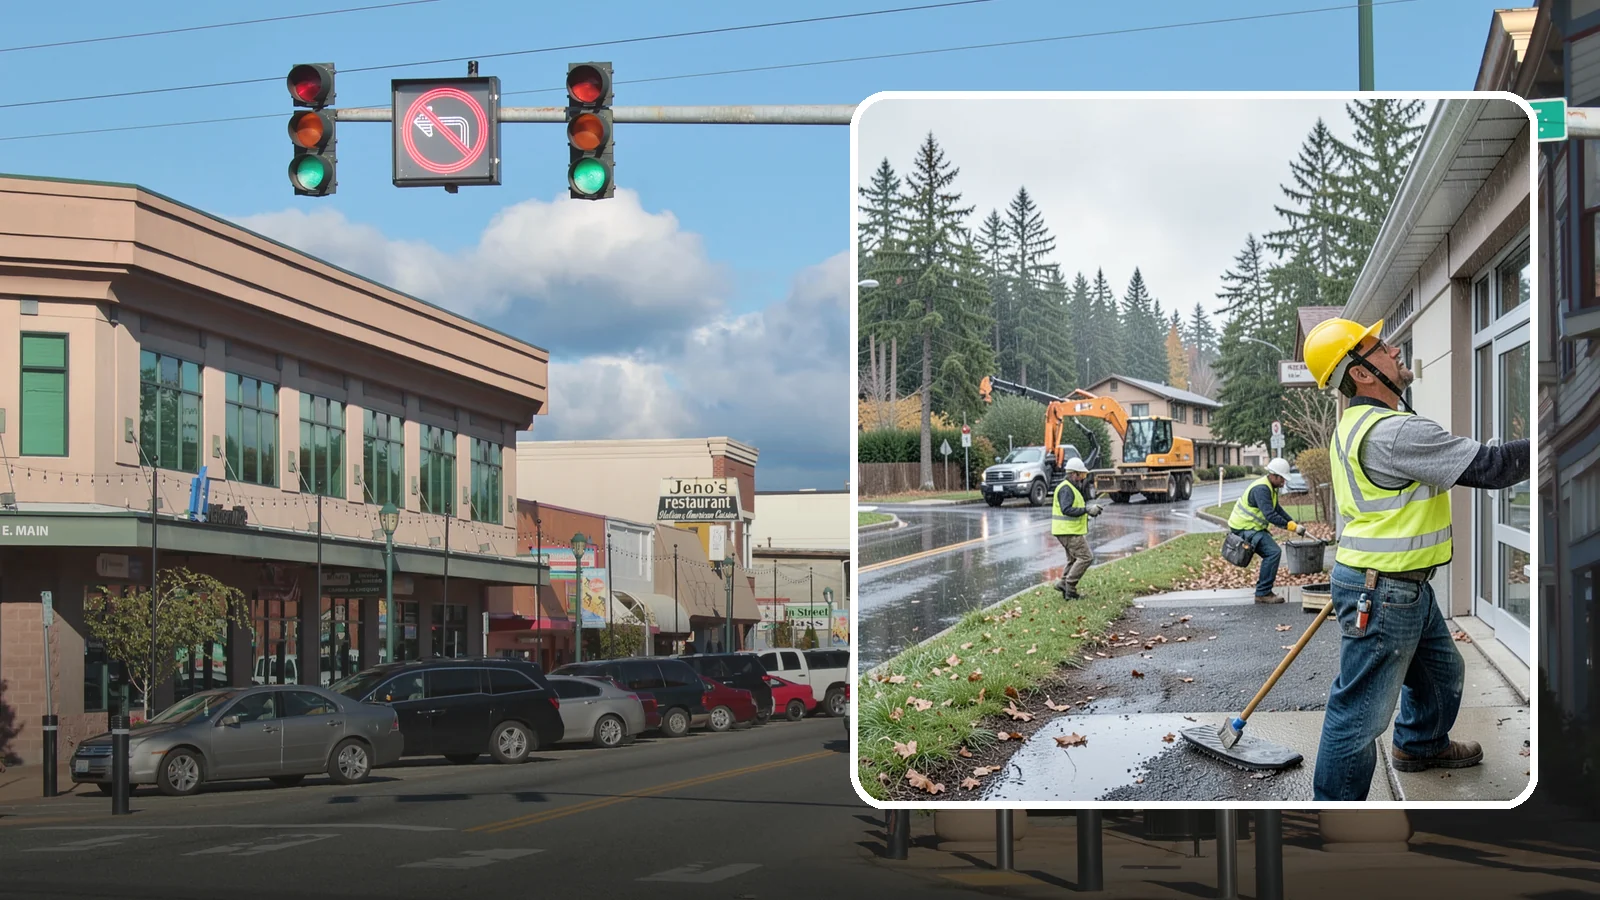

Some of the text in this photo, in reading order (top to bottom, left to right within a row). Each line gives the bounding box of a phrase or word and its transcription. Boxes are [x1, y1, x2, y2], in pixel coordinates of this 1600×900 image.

[670, 480, 727, 494] Jeno's
[665, 496, 730, 509] restaurant
[659, 510, 681, 519] Italian
[686, 510, 714, 519] American
[715, 509, 737, 519] Cuisine
[2, 525, 49, 536] E. MAIN
[797, 608, 828, 616] Street
